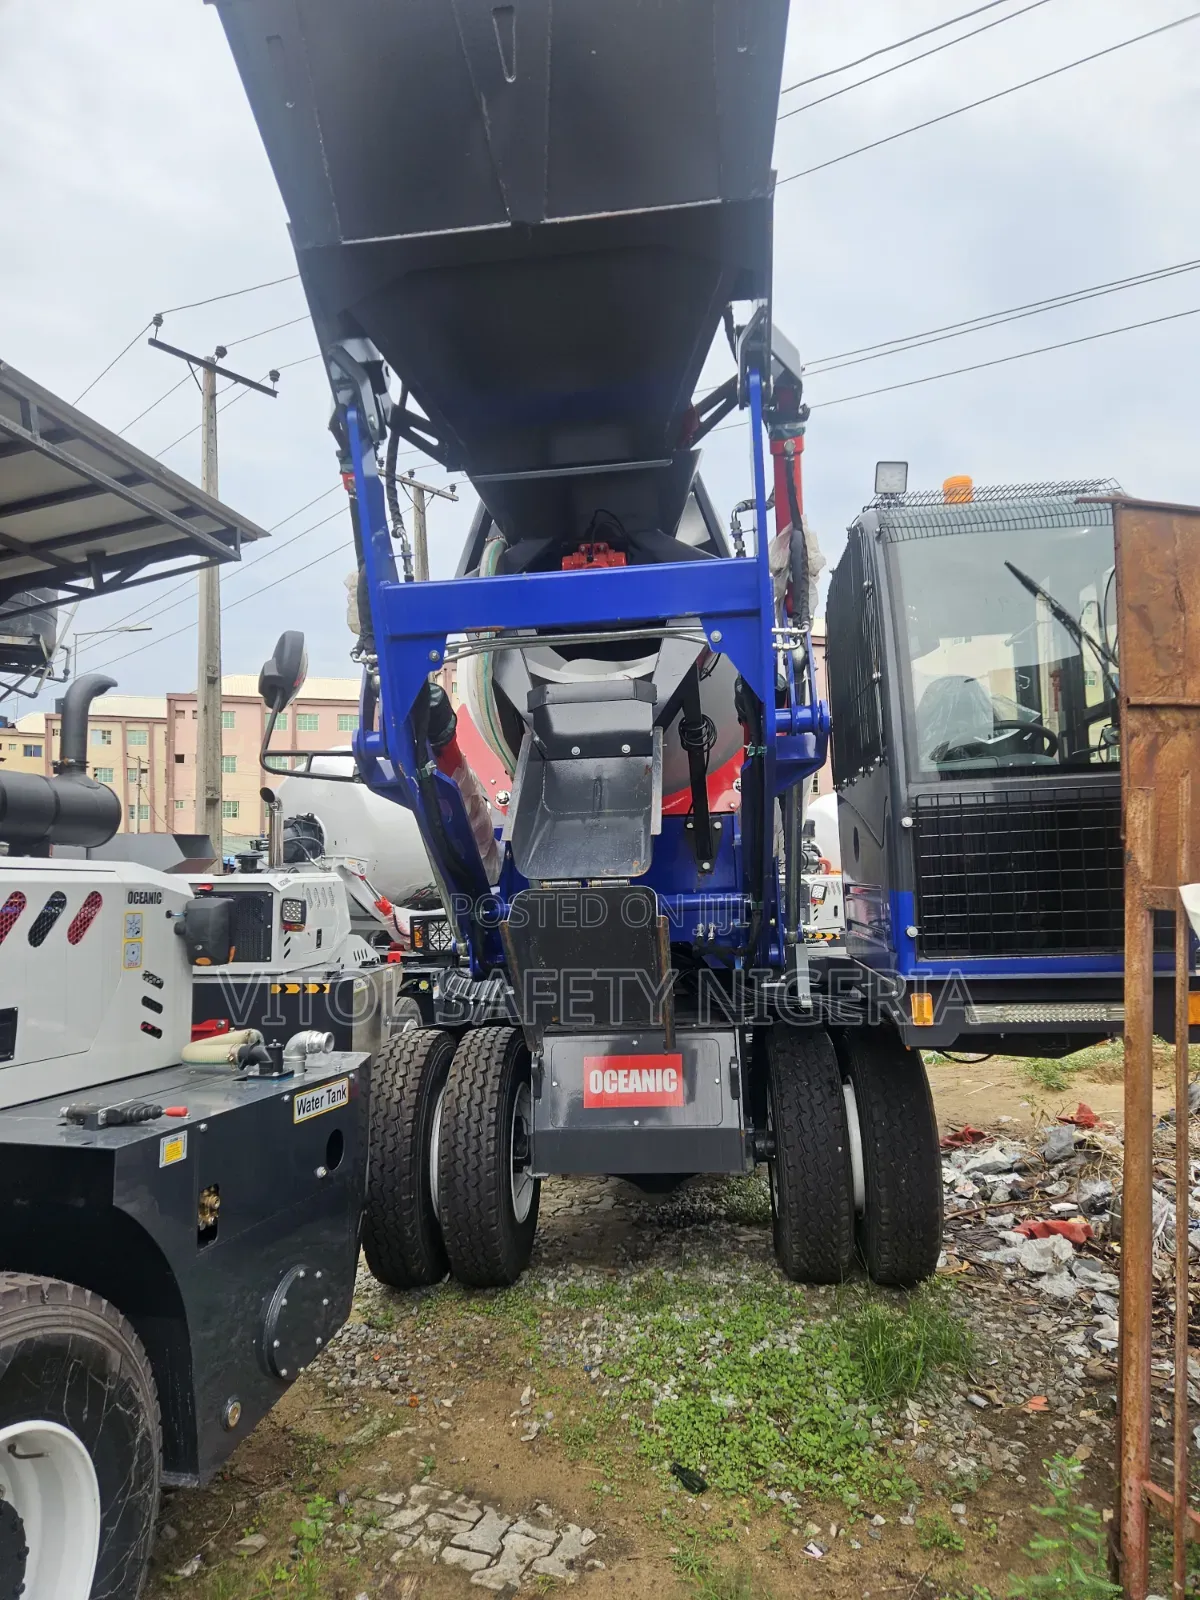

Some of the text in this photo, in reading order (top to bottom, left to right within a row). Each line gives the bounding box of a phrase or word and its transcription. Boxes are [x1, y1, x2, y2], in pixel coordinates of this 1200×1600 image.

[127, 891, 163, 905] OCEANIC
[589, 1068, 678, 1094] OCEANIC
[296, 1084, 347, 1116] Water Tank
